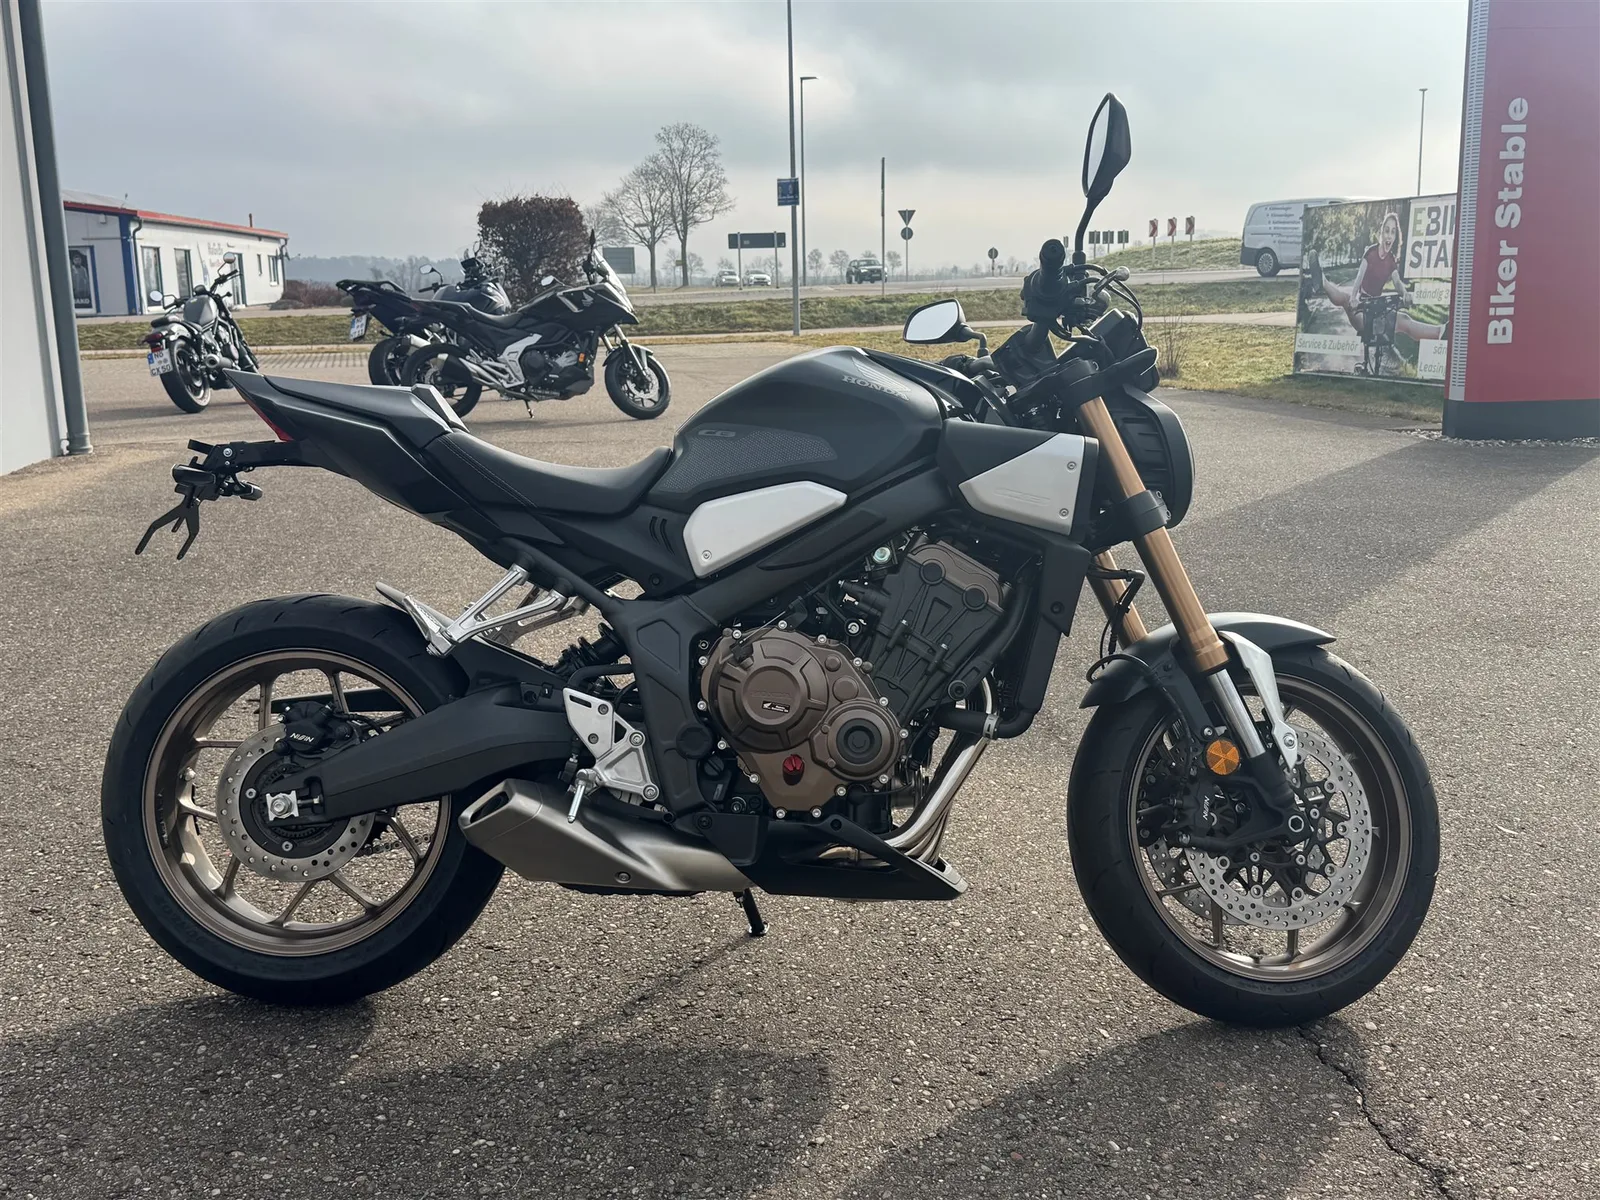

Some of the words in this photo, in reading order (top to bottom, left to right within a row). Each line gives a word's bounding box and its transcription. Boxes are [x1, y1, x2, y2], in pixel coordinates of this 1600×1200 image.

[1495, 97, 1528, 229] Stable
[1409, 240, 1453, 269] STA
[1487, 240, 1518, 344] Biker
[1297, 338, 1321, 349] Service
[1328, 340, 1359, 352] Zubehör
[842, 375, 910, 401] HONDA
